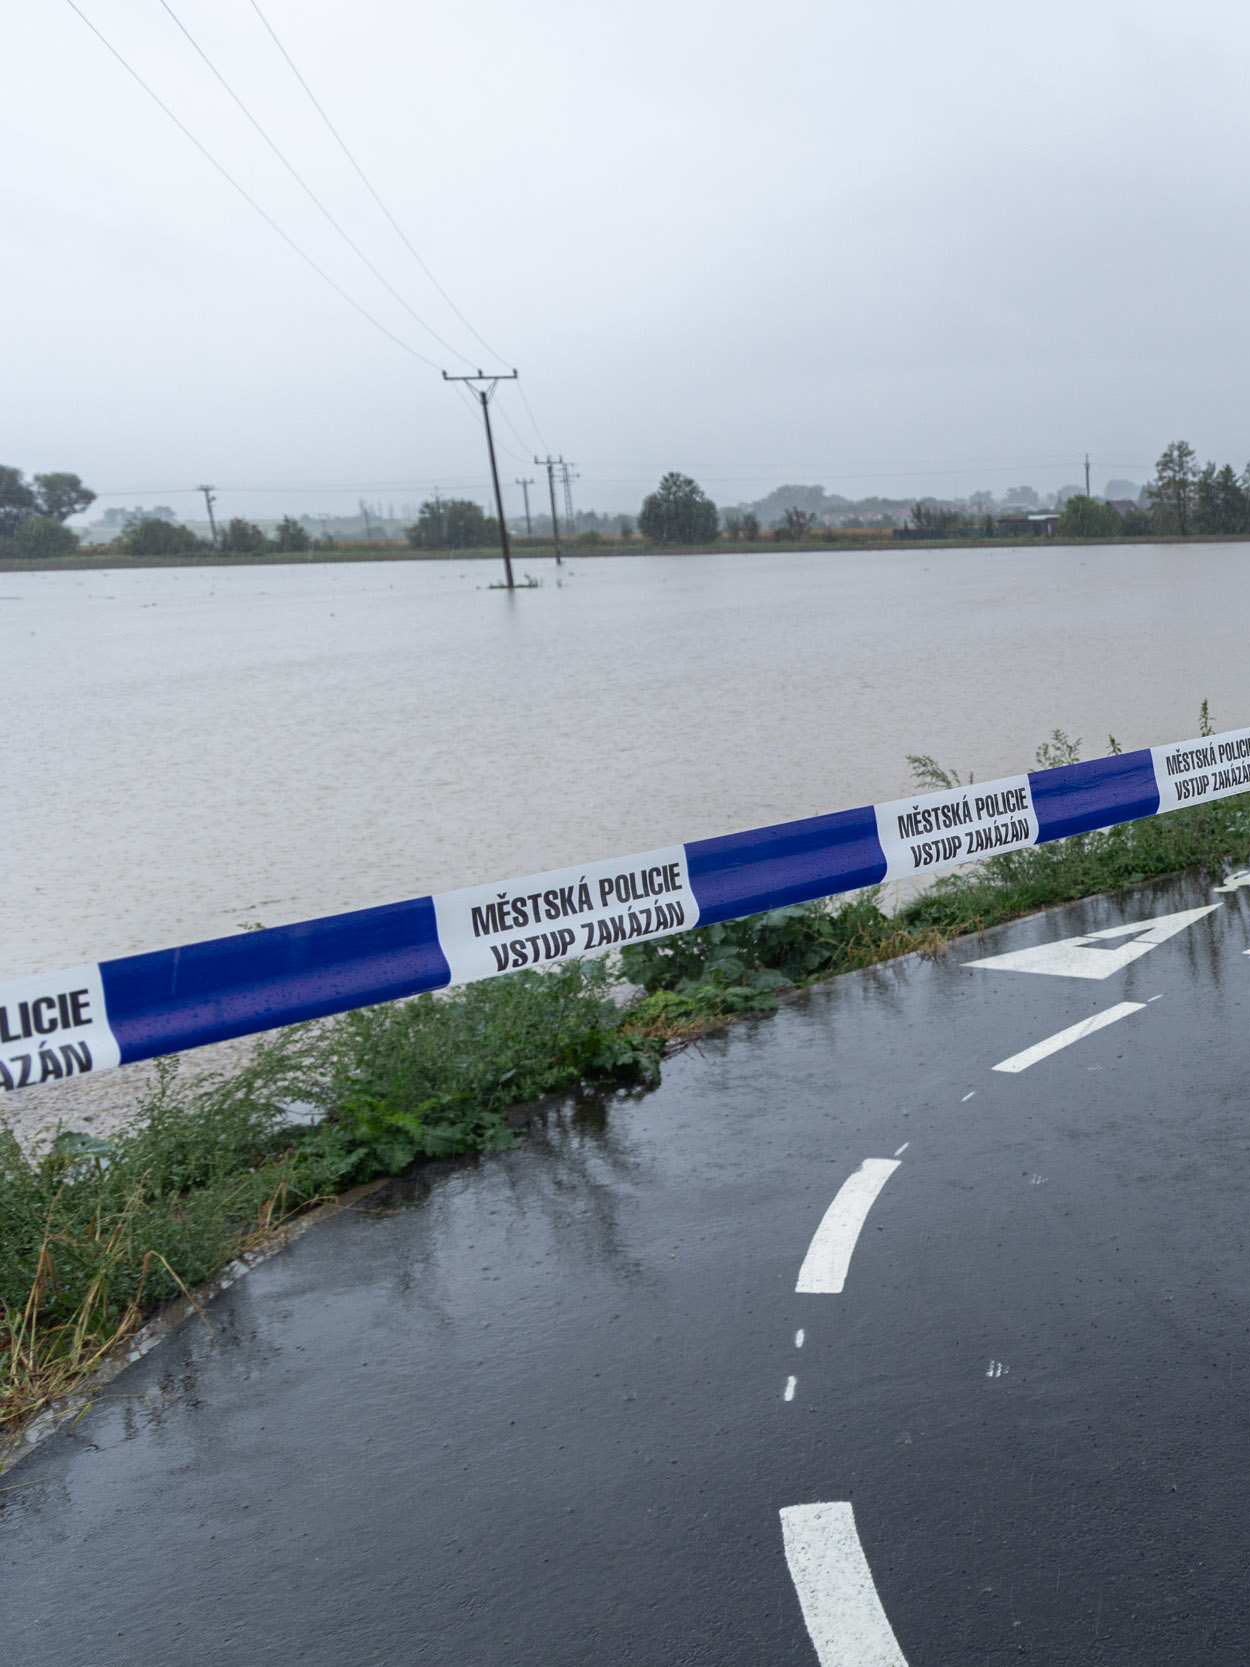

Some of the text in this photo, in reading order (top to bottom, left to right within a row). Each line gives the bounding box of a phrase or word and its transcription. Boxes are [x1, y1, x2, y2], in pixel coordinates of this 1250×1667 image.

[1166, 741, 1217, 776] MĚSTSKÁ
[897, 787, 1028, 840] MĚSTSKÁ POLICIE
[1174, 774, 1210, 801] VSTUP
[910, 816, 1030, 868] VSTUP ZAKÁZÁN
[471, 862, 682, 938] MĚSTSKÁ POLICIE
[490, 900, 685, 972] VSTUP ZAKÁZÁN
